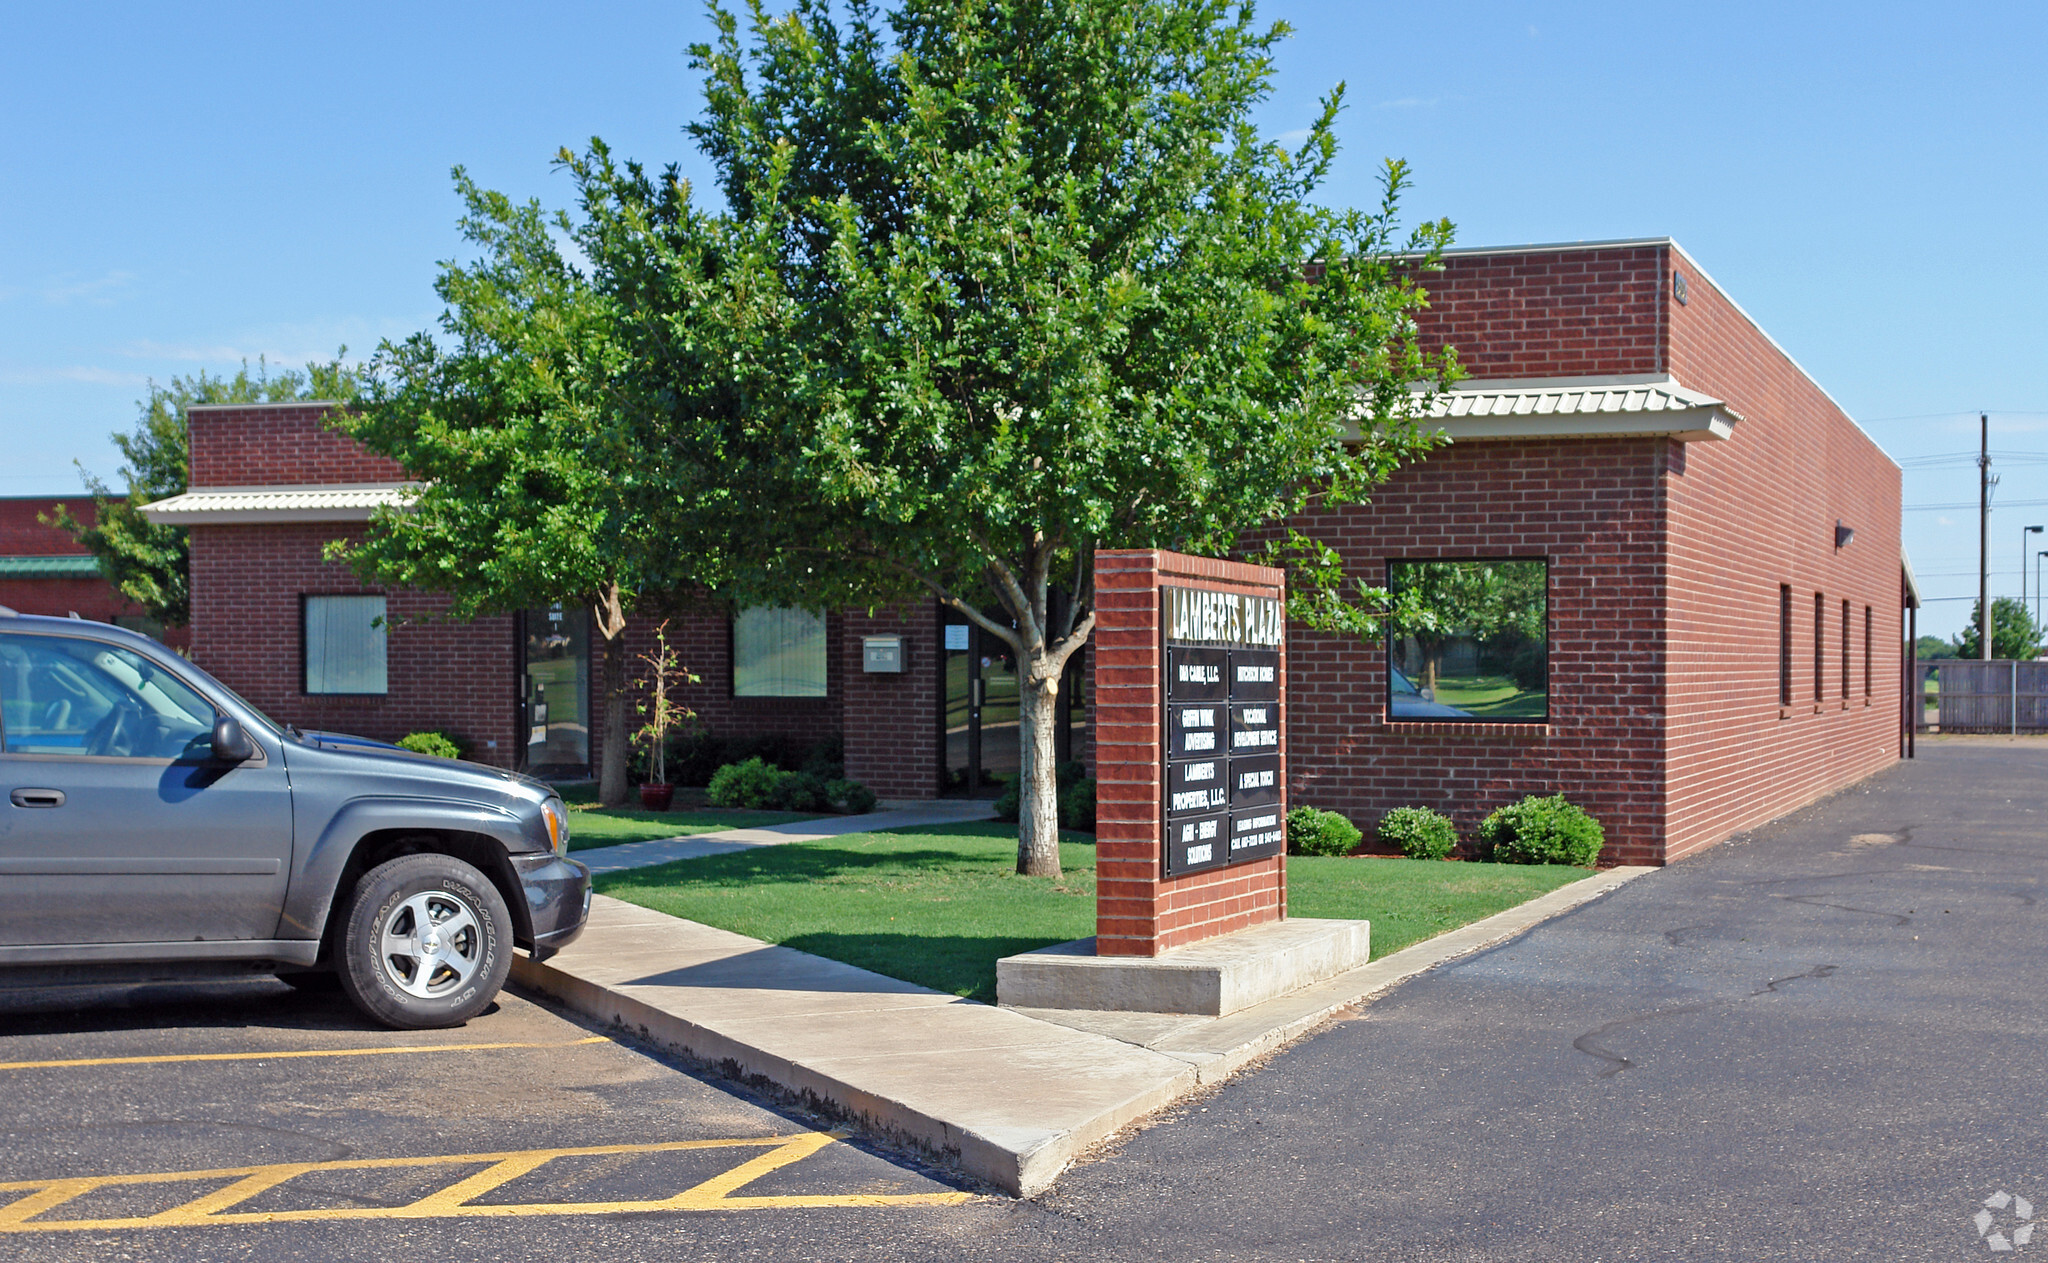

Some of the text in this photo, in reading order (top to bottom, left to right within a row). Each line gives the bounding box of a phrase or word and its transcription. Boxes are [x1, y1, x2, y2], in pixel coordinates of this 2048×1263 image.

[549, 612, 563, 621] SUITE
[1246, 597, 1282, 645] PLAZA
[1185, 732, 1215, 751] ADVERTISING
[1239, 774, 1244, 789] A
[443, 879, 497, 982] WRANGLER
[368, 890, 408, 1005] GOODYEAR
